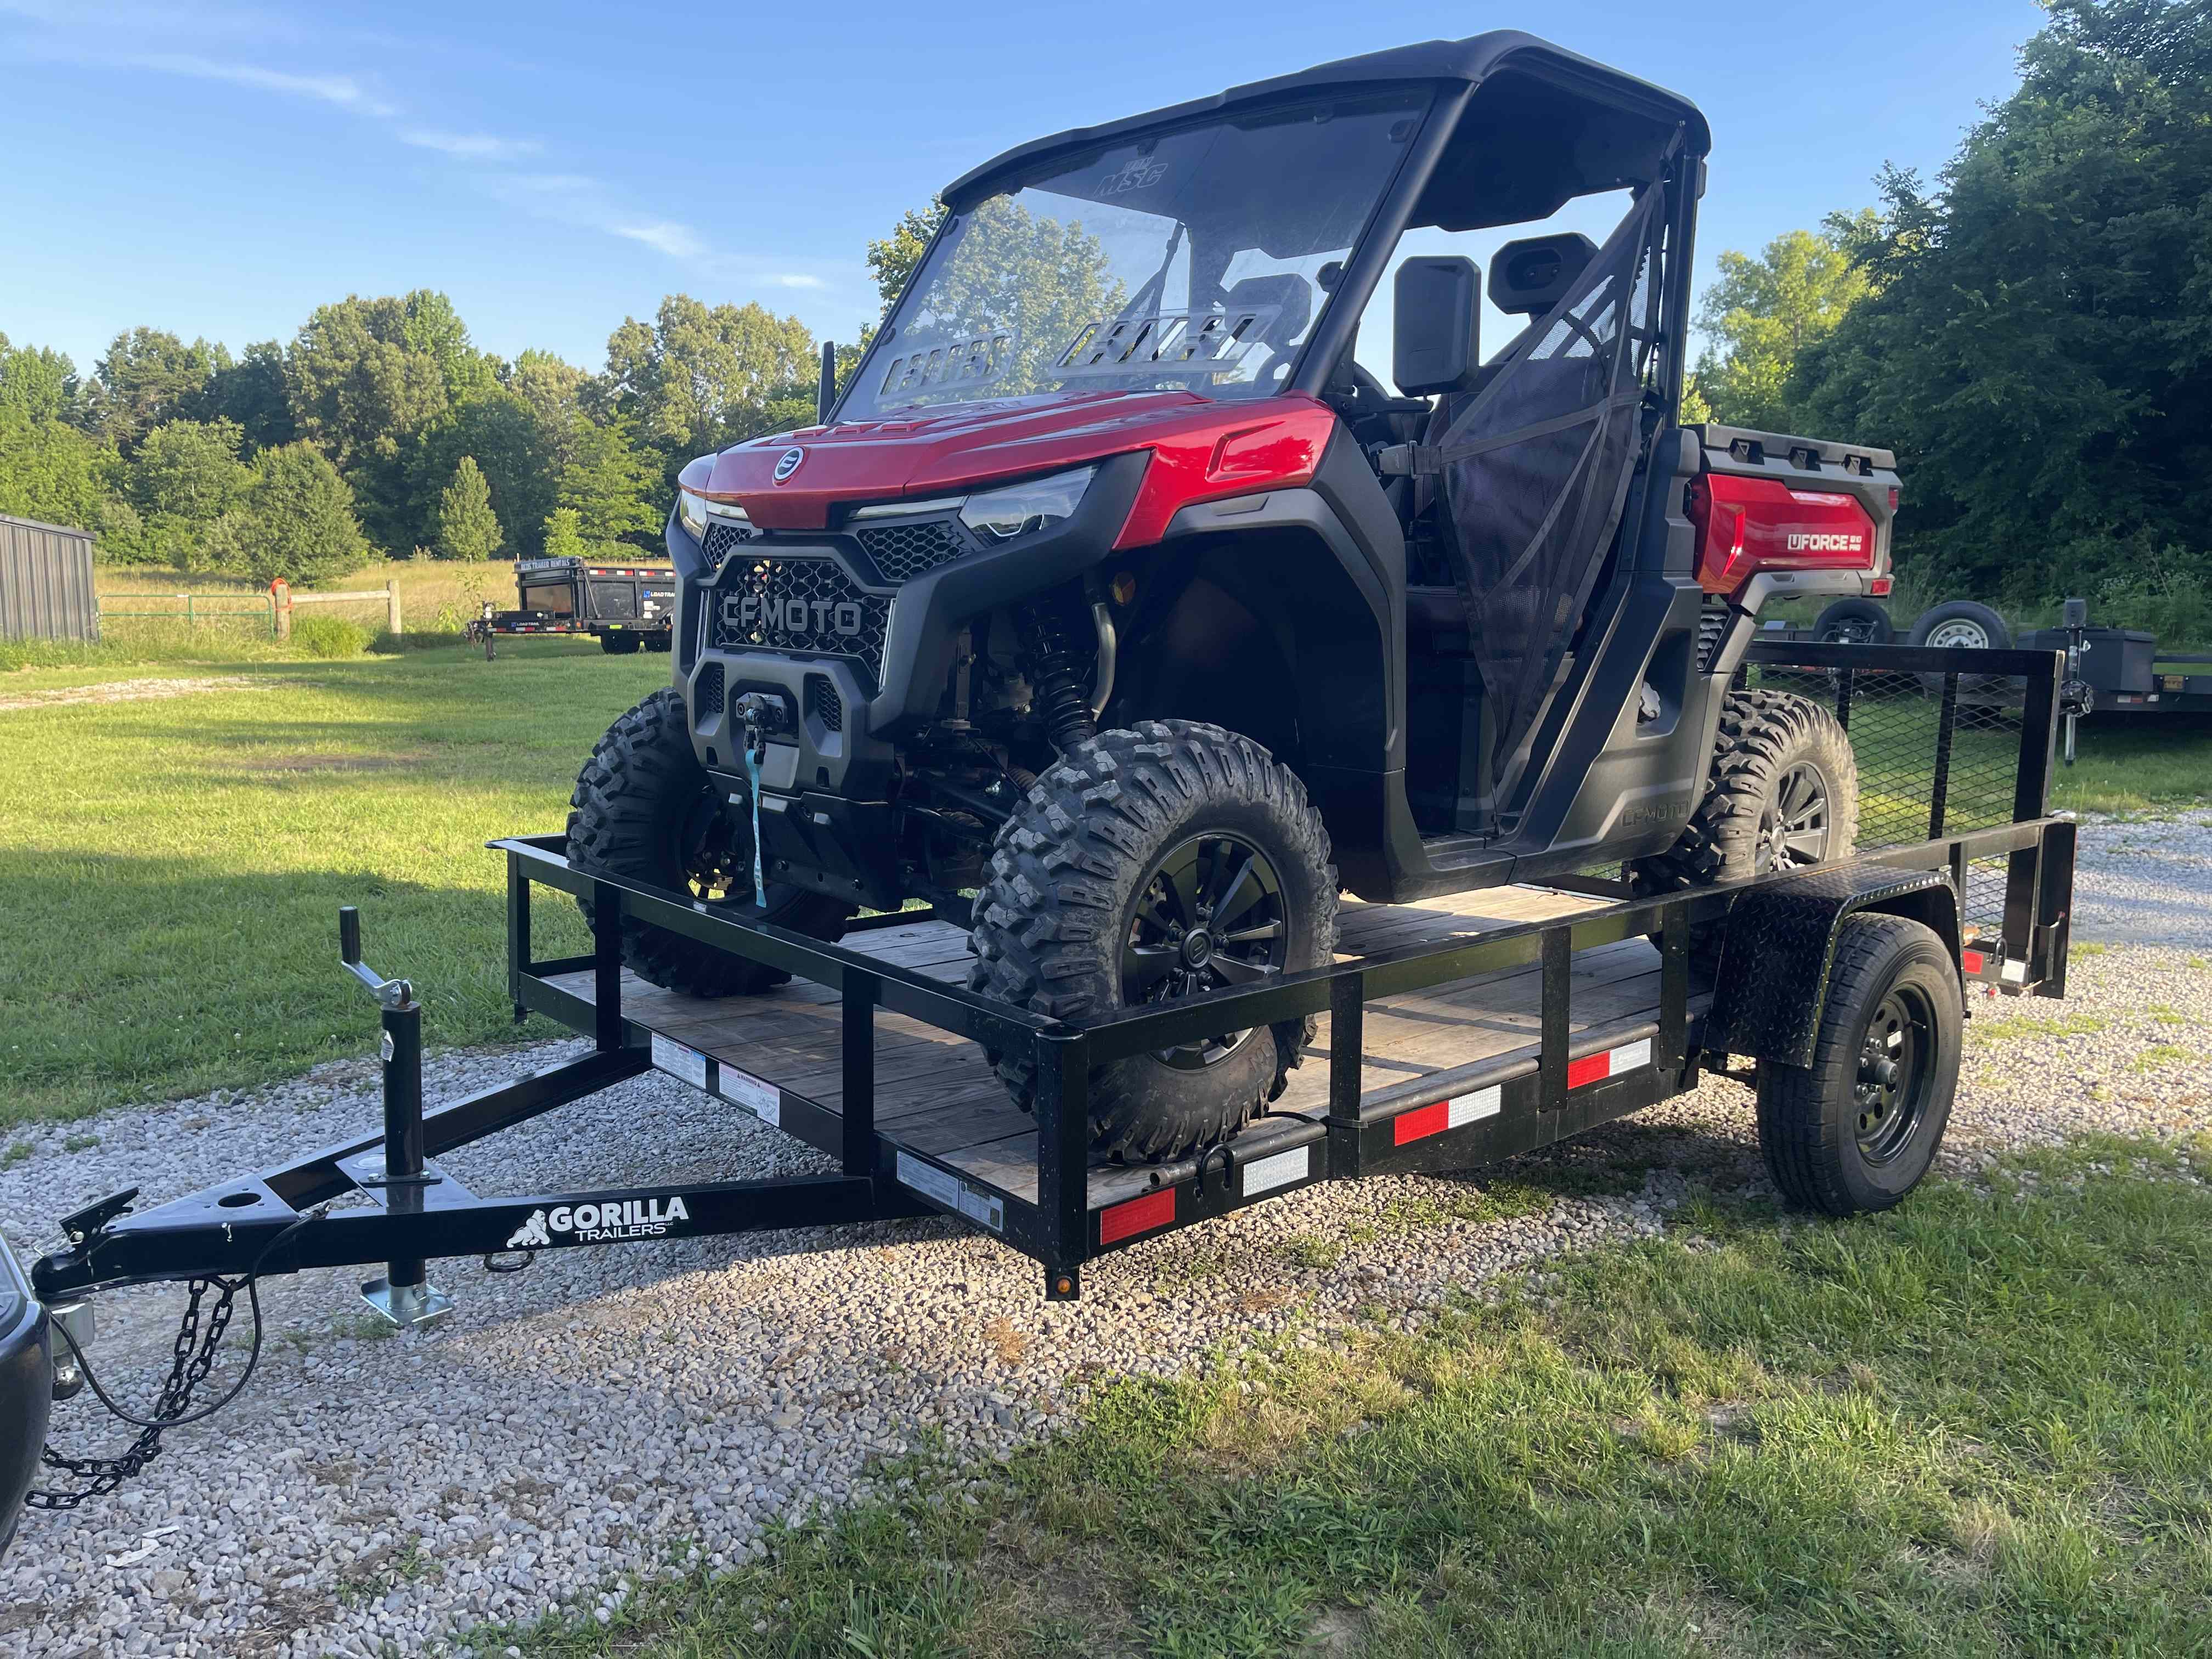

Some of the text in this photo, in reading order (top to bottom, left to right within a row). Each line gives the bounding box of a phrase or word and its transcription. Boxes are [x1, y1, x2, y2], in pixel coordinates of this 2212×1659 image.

[1787, 534, 1849, 550] UFORCE
[550, 558, 570, 567] RENTALS
[724, 596, 861, 635] CFMOTO
[1622, 800, 1689, 826] CFMOTO
[549, 1197, 689, 1232] GORILLA
[575, 1223, 667, 1242] TRAILERS
